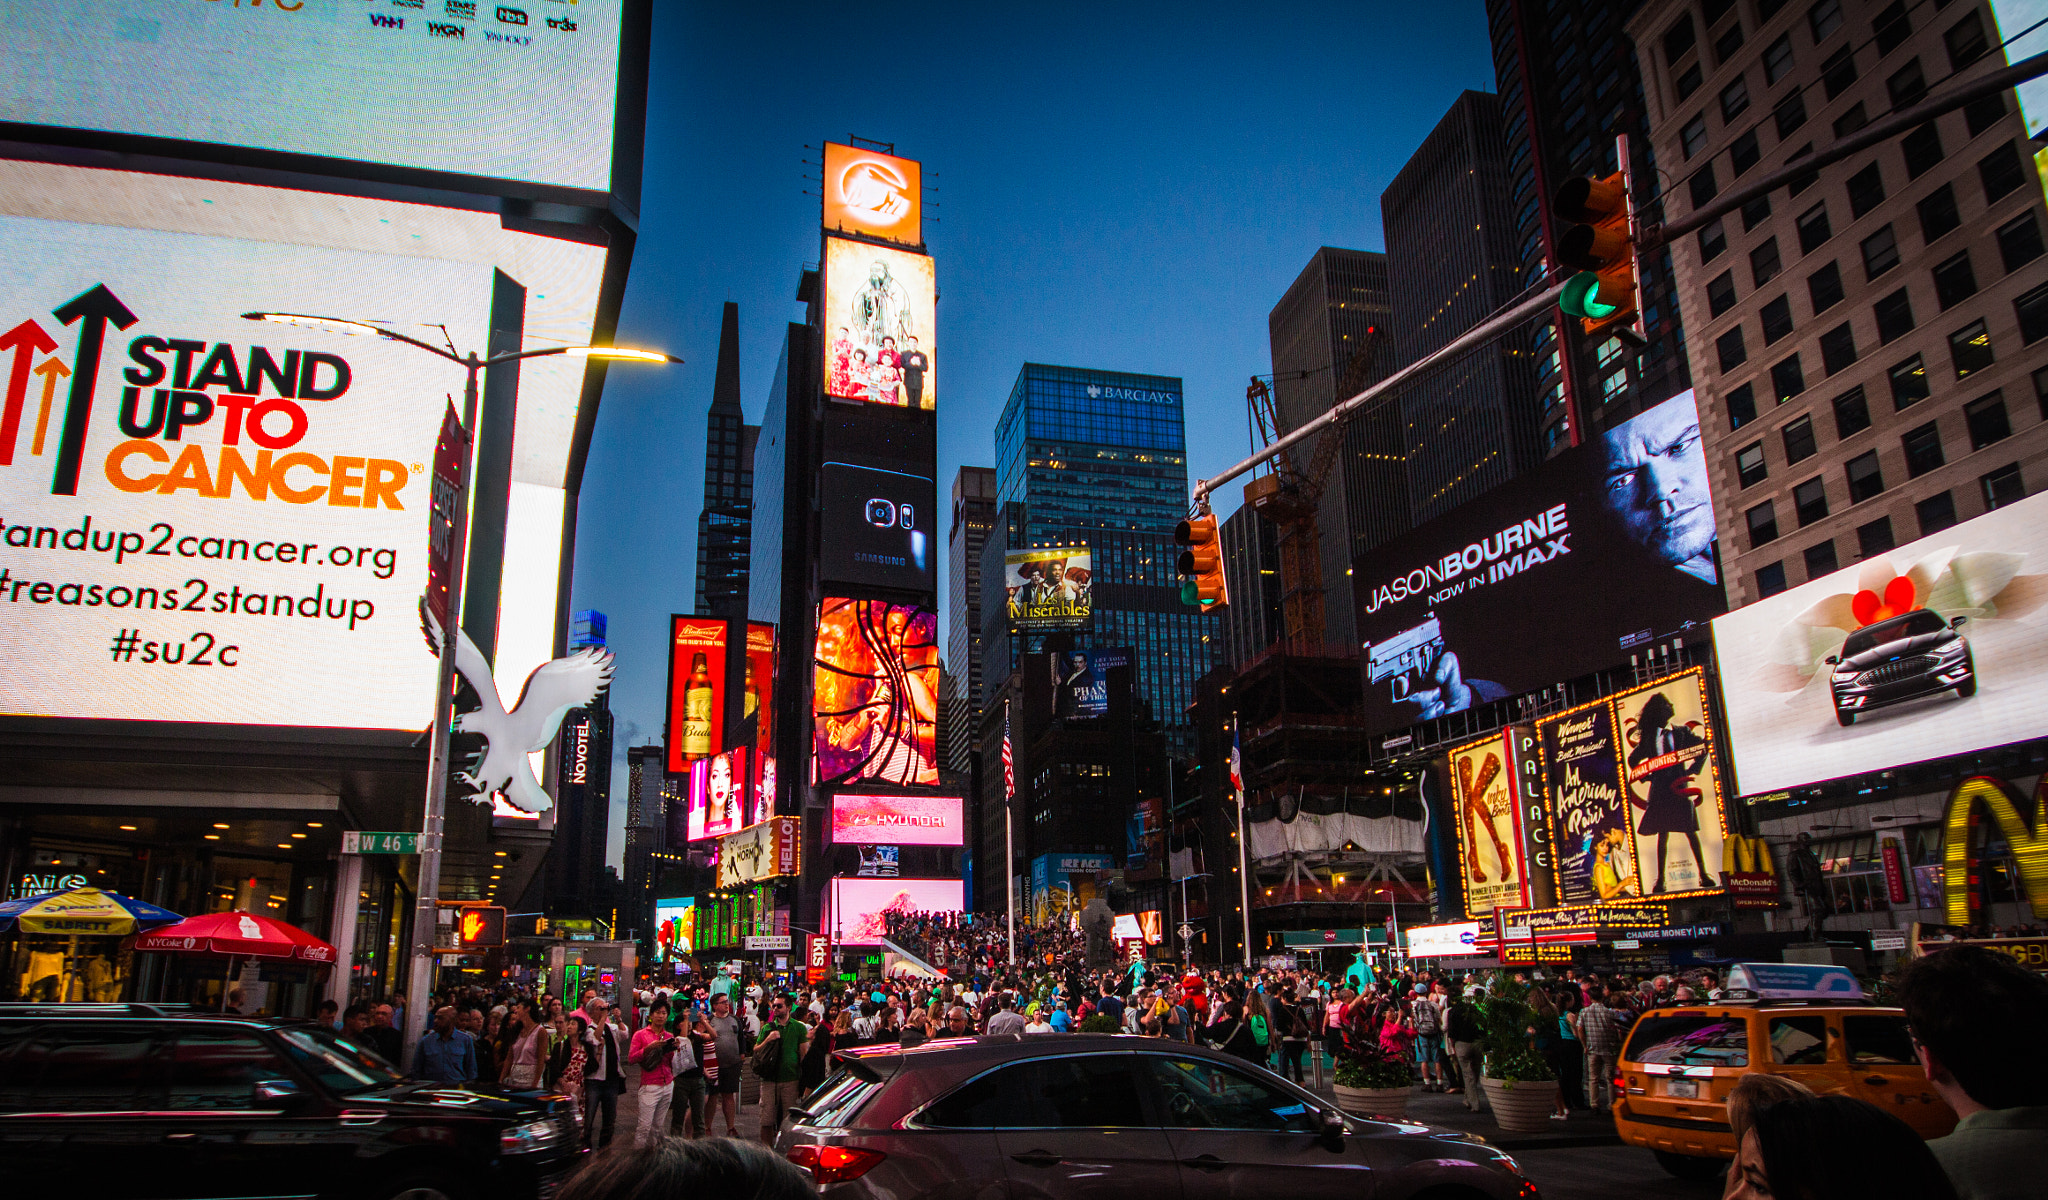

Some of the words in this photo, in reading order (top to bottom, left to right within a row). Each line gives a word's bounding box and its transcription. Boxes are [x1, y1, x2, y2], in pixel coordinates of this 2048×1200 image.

[122, 333, 353, 401] STAND
[1105, 387, 1174, 405] BARCLAYS
[854, 552, 906, 566] SAMSUNG
[1427, 580, 1466, 607] NOW
[1468, 572, 1486, 590] IN
[1488, 532, 1571, 585] IMAX
[1009, 599, 1090, 619] Misérables
[1037, 593, 1058, 605] Les
[109, 628, 240, 667] #su2c
[1557, 713, 1597, 739] Winner!
[573, 720, 590, 784] NOVOTEL
[1565, 763, 1582, 792] An
[1631, 765, 1648, 780] FINAL
[1648, 753, 1677, 772] MONTHS
[1522, 737, 1548, 868] PALACE
[1556, 782, 1620, 819] American
[876, 815, 946, 827] HYUNDAI
[1567, 805, 1604, 835] Paris
[362, 835, 376, 851] W
[382, 836, 401, 851] 46
[781, 819, 794, 873] HELLO!
[1730, 879, 1777, 887] McDonald's
[44, 921, 112, 931] SABRETT
[1626, 930, 1660, 940] CHANGE
[1661, 928, 1693, 938] MONEY
[1697, 926, 1718, 936] ATM
[812, 936, 829, 967] tkts
